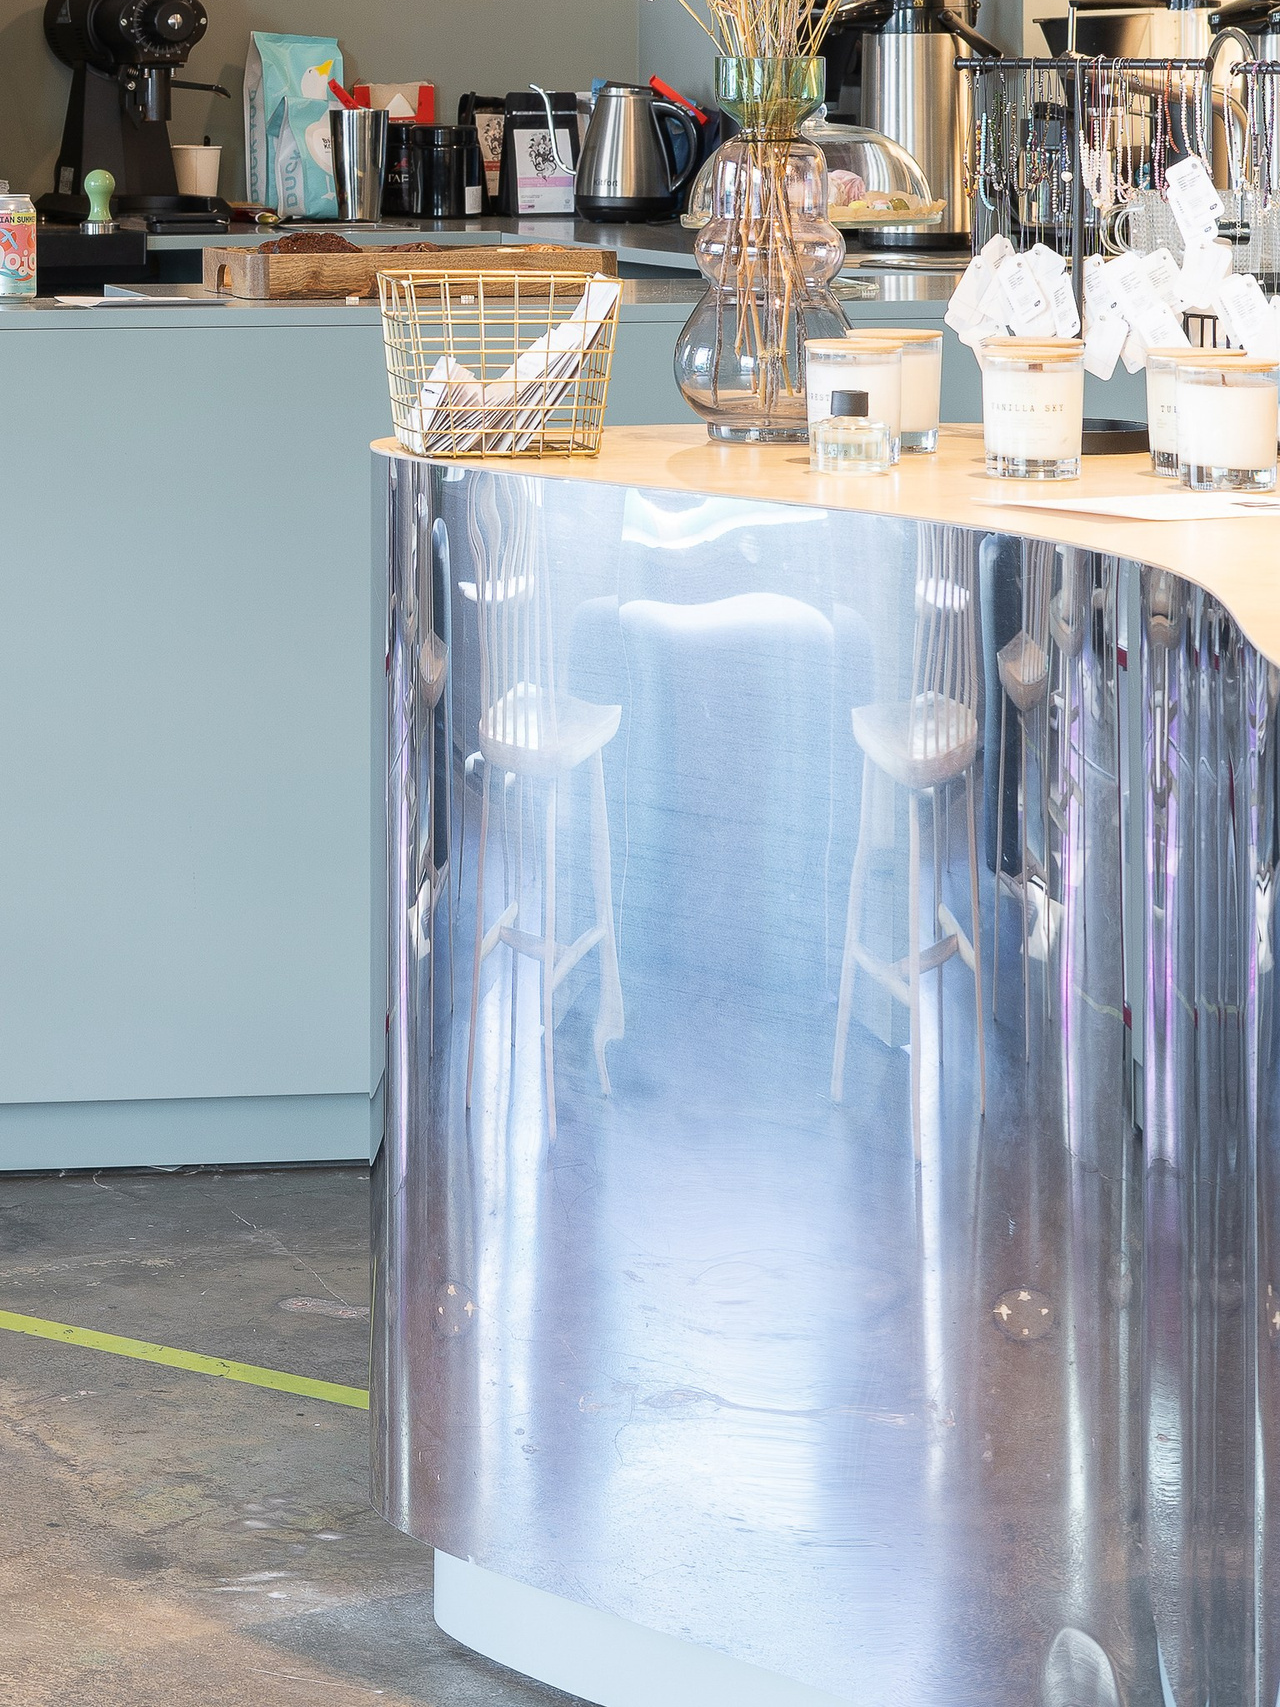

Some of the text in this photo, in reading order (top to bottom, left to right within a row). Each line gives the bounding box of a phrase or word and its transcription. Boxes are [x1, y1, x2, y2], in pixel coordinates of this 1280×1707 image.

[285, 149, 302, 208] DUCK
[388, 174, 409, 183] ГАР
[16, 216, 36, 224] SUMME
[1044, 404, 1064, 413] SKY
